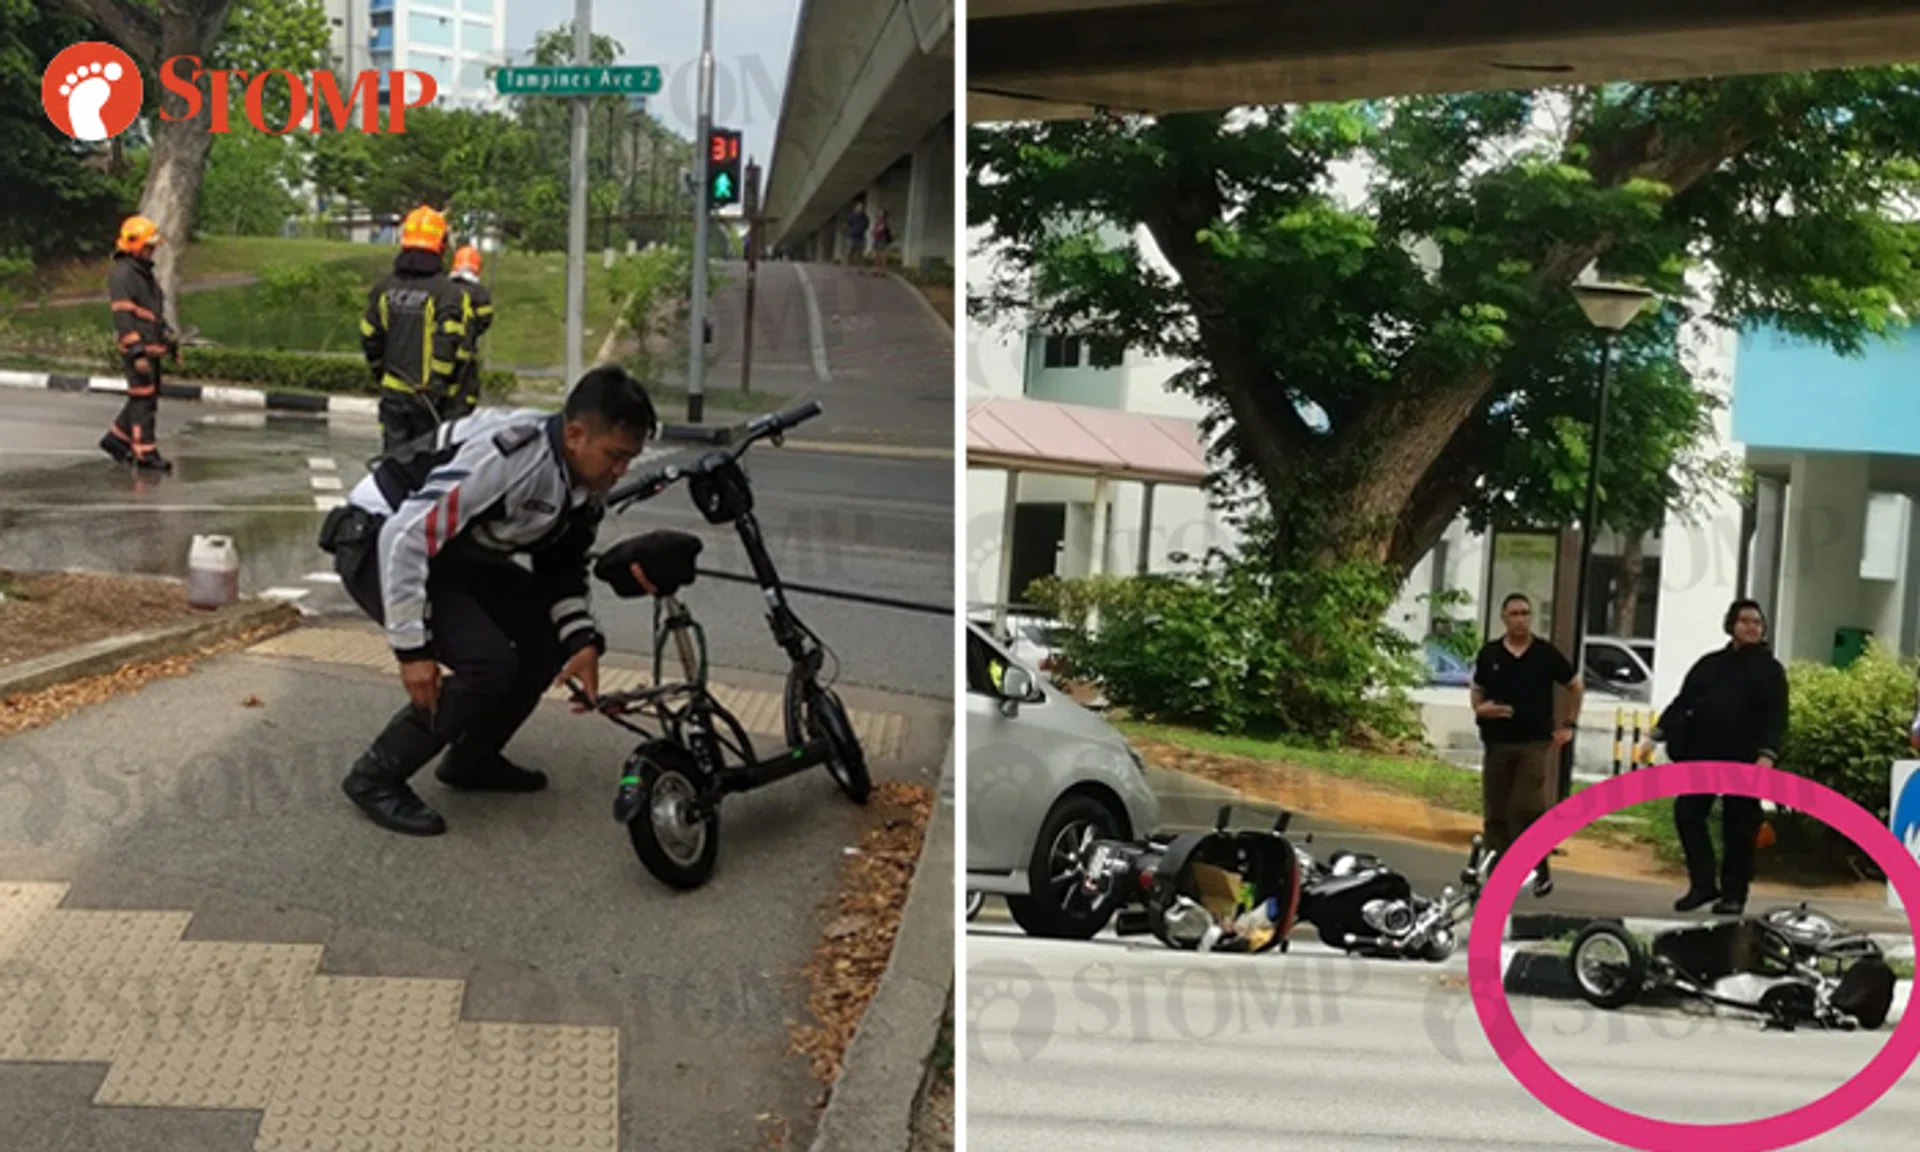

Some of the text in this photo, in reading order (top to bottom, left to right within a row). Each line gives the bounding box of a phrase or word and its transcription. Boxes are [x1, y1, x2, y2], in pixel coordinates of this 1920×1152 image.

[506, 70, 653, 91] Tampines Ave 2
[712, 136, 738, 161] 31
